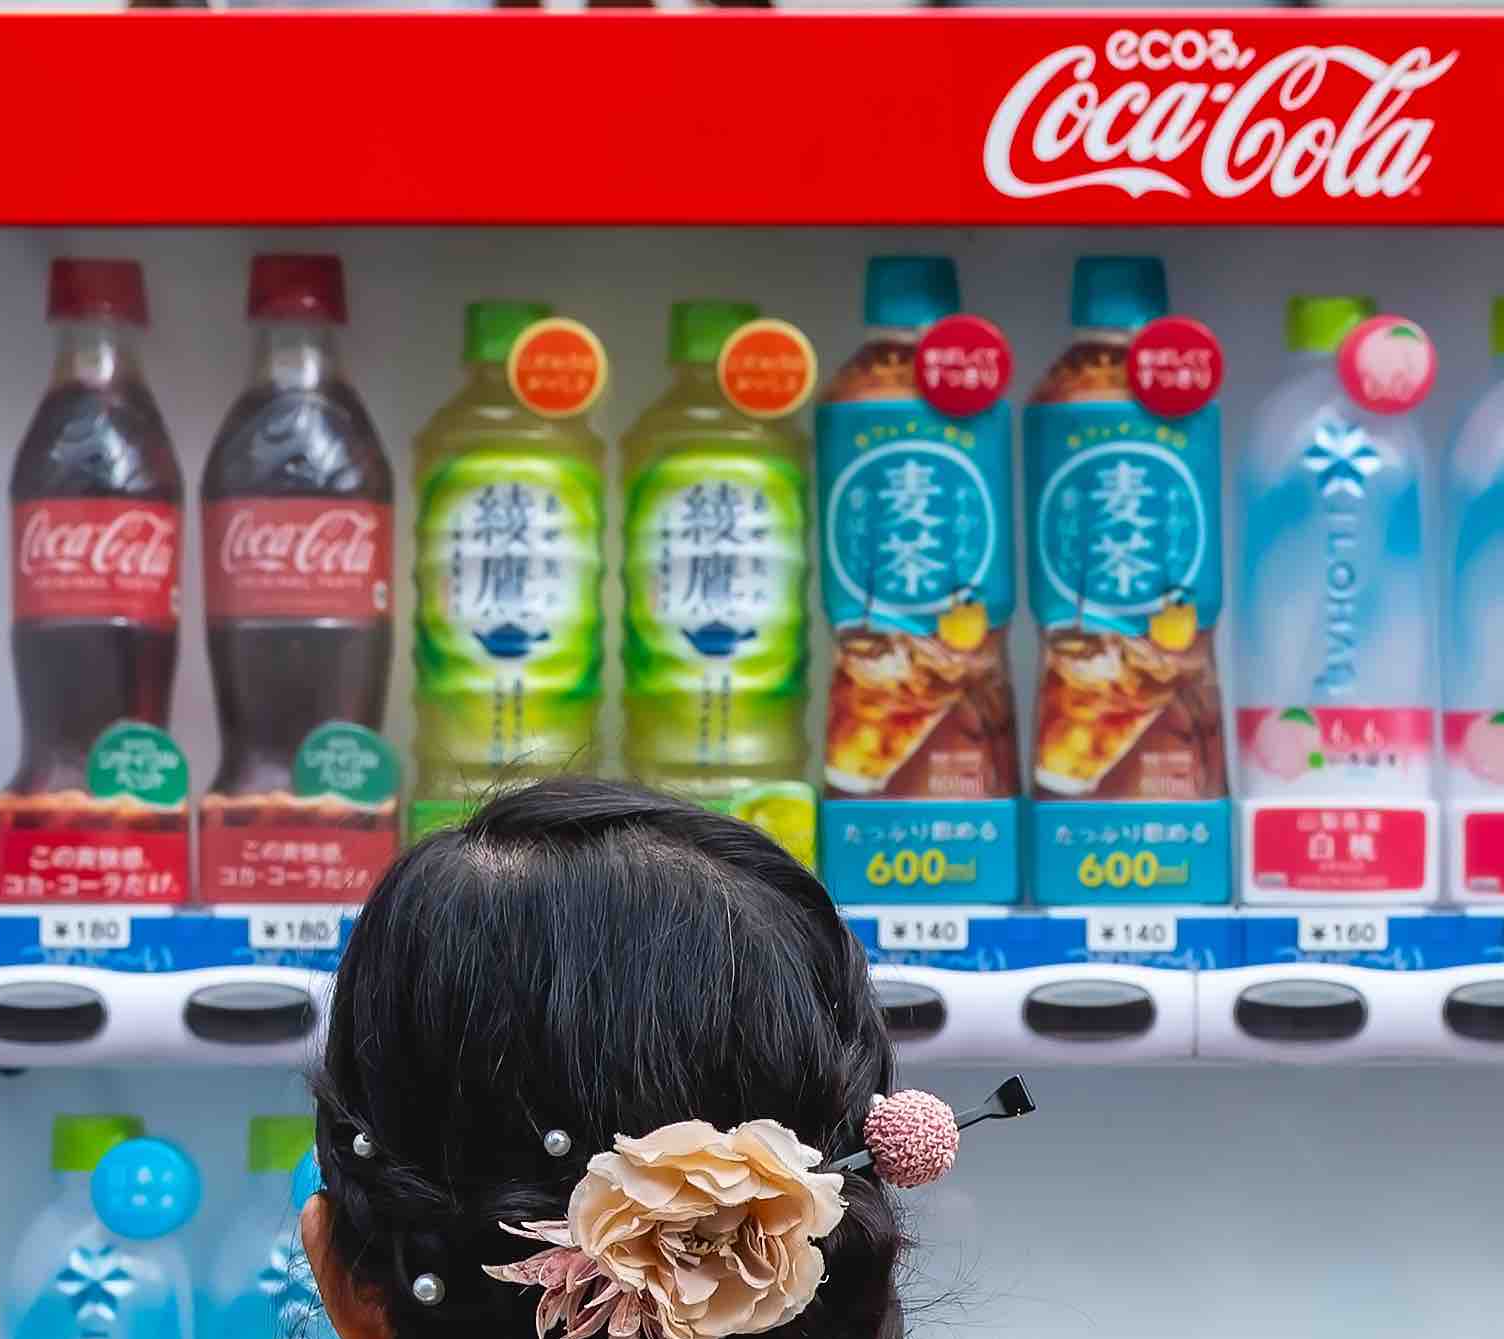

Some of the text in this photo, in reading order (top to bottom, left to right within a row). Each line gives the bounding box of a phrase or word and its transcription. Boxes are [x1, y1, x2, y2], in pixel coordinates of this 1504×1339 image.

[983, 45, 1460, 199] Coca-Cola
[21, 509, 173, 575] Coca-Cola
[221, 509, 377, 575] Coca-Cola
[877, 459, 945, 597] 麦茶
[1090, 460, 1158, 598] 麦茶
[865, 848, 977, 887] 600ml
[1077, 850, 1190, 889] 600ml
